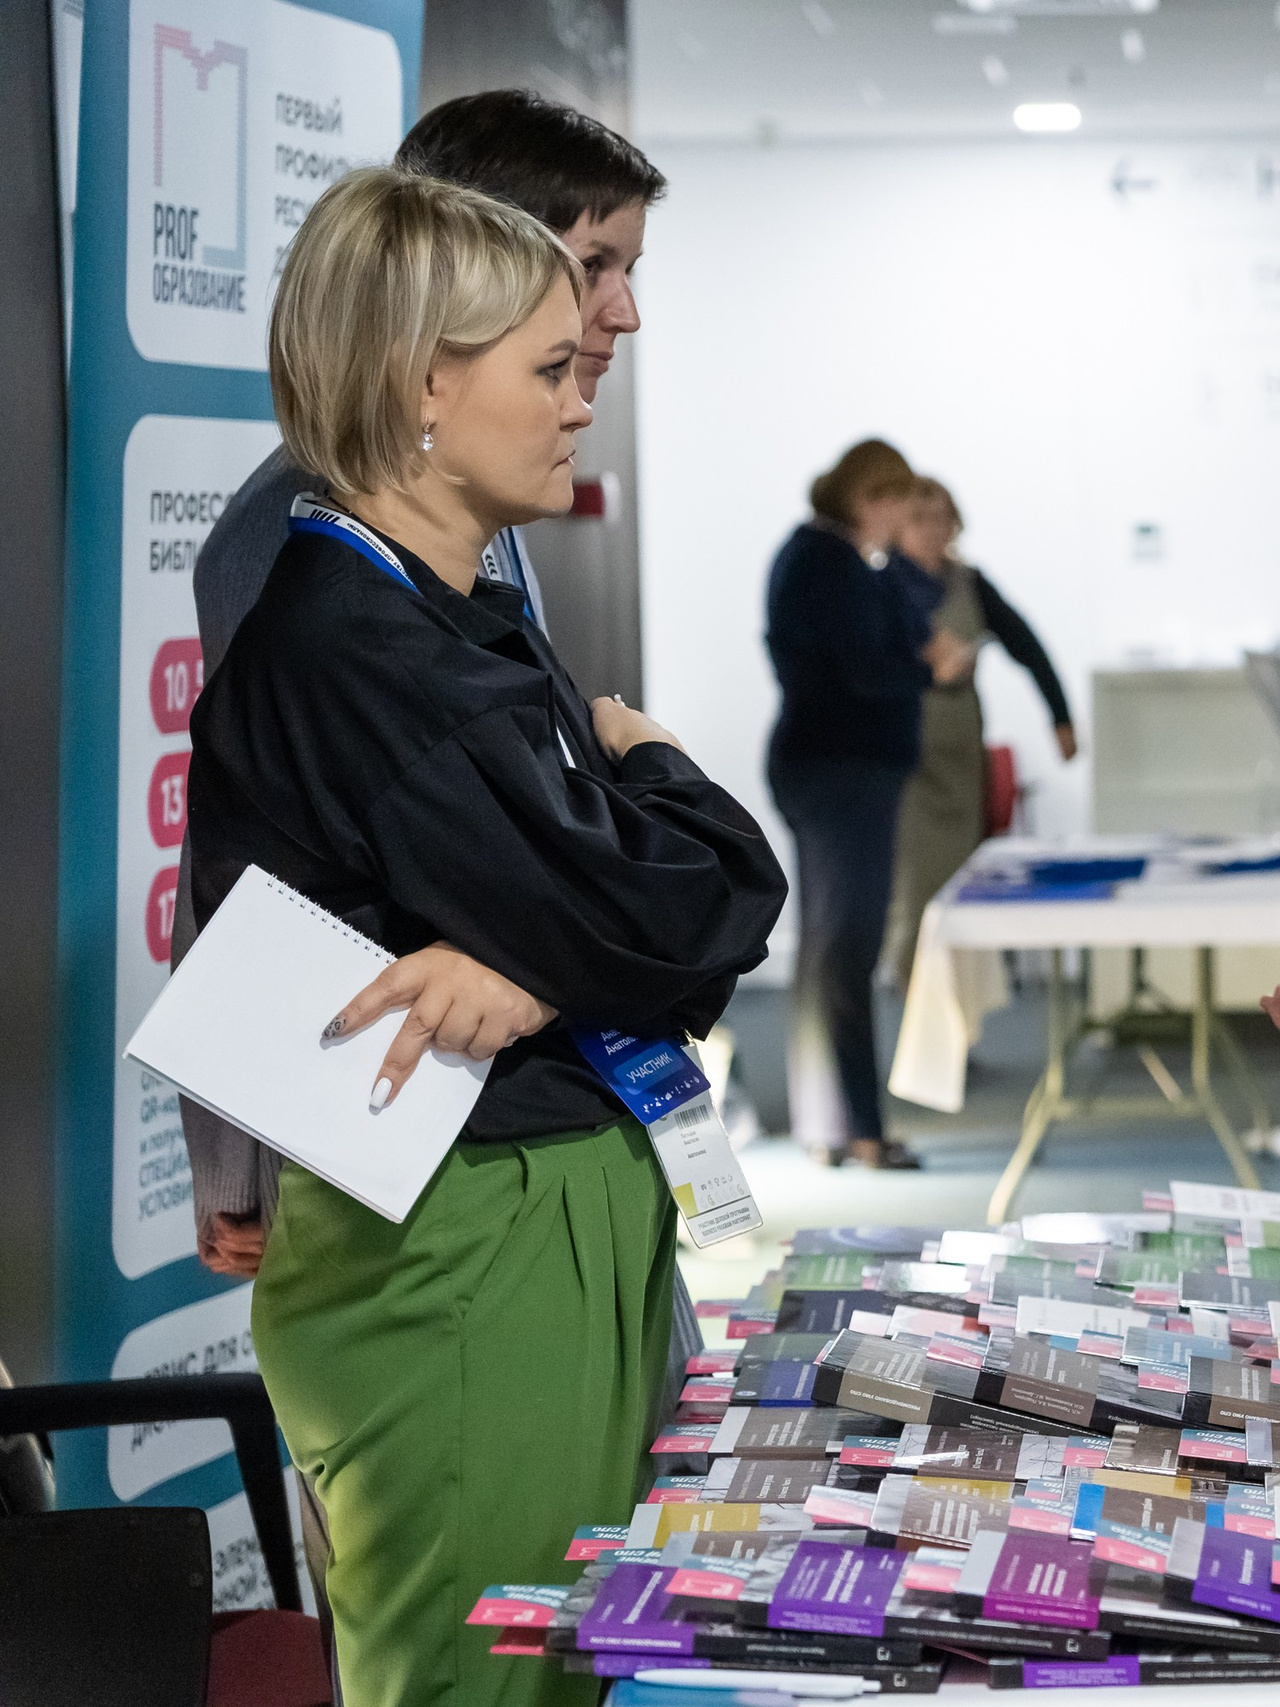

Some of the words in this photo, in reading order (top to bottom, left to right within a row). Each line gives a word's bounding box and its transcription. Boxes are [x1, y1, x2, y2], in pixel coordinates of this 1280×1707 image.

[275, 92, 343, 135] ПЕРВЫЙ
[153, 201, 199, 261] PROF
[152, 263, 246, 314] ОБРАЗОВАНИЕ
[164, 662, 189, 711] 10
[161, 774, 184, 827] 13
[626, 1052, 673, 1083] УЧАСТНИК
[1196, 1432, 1224, 1440] СПО
[592, 1526, 620, 1534] СПО
